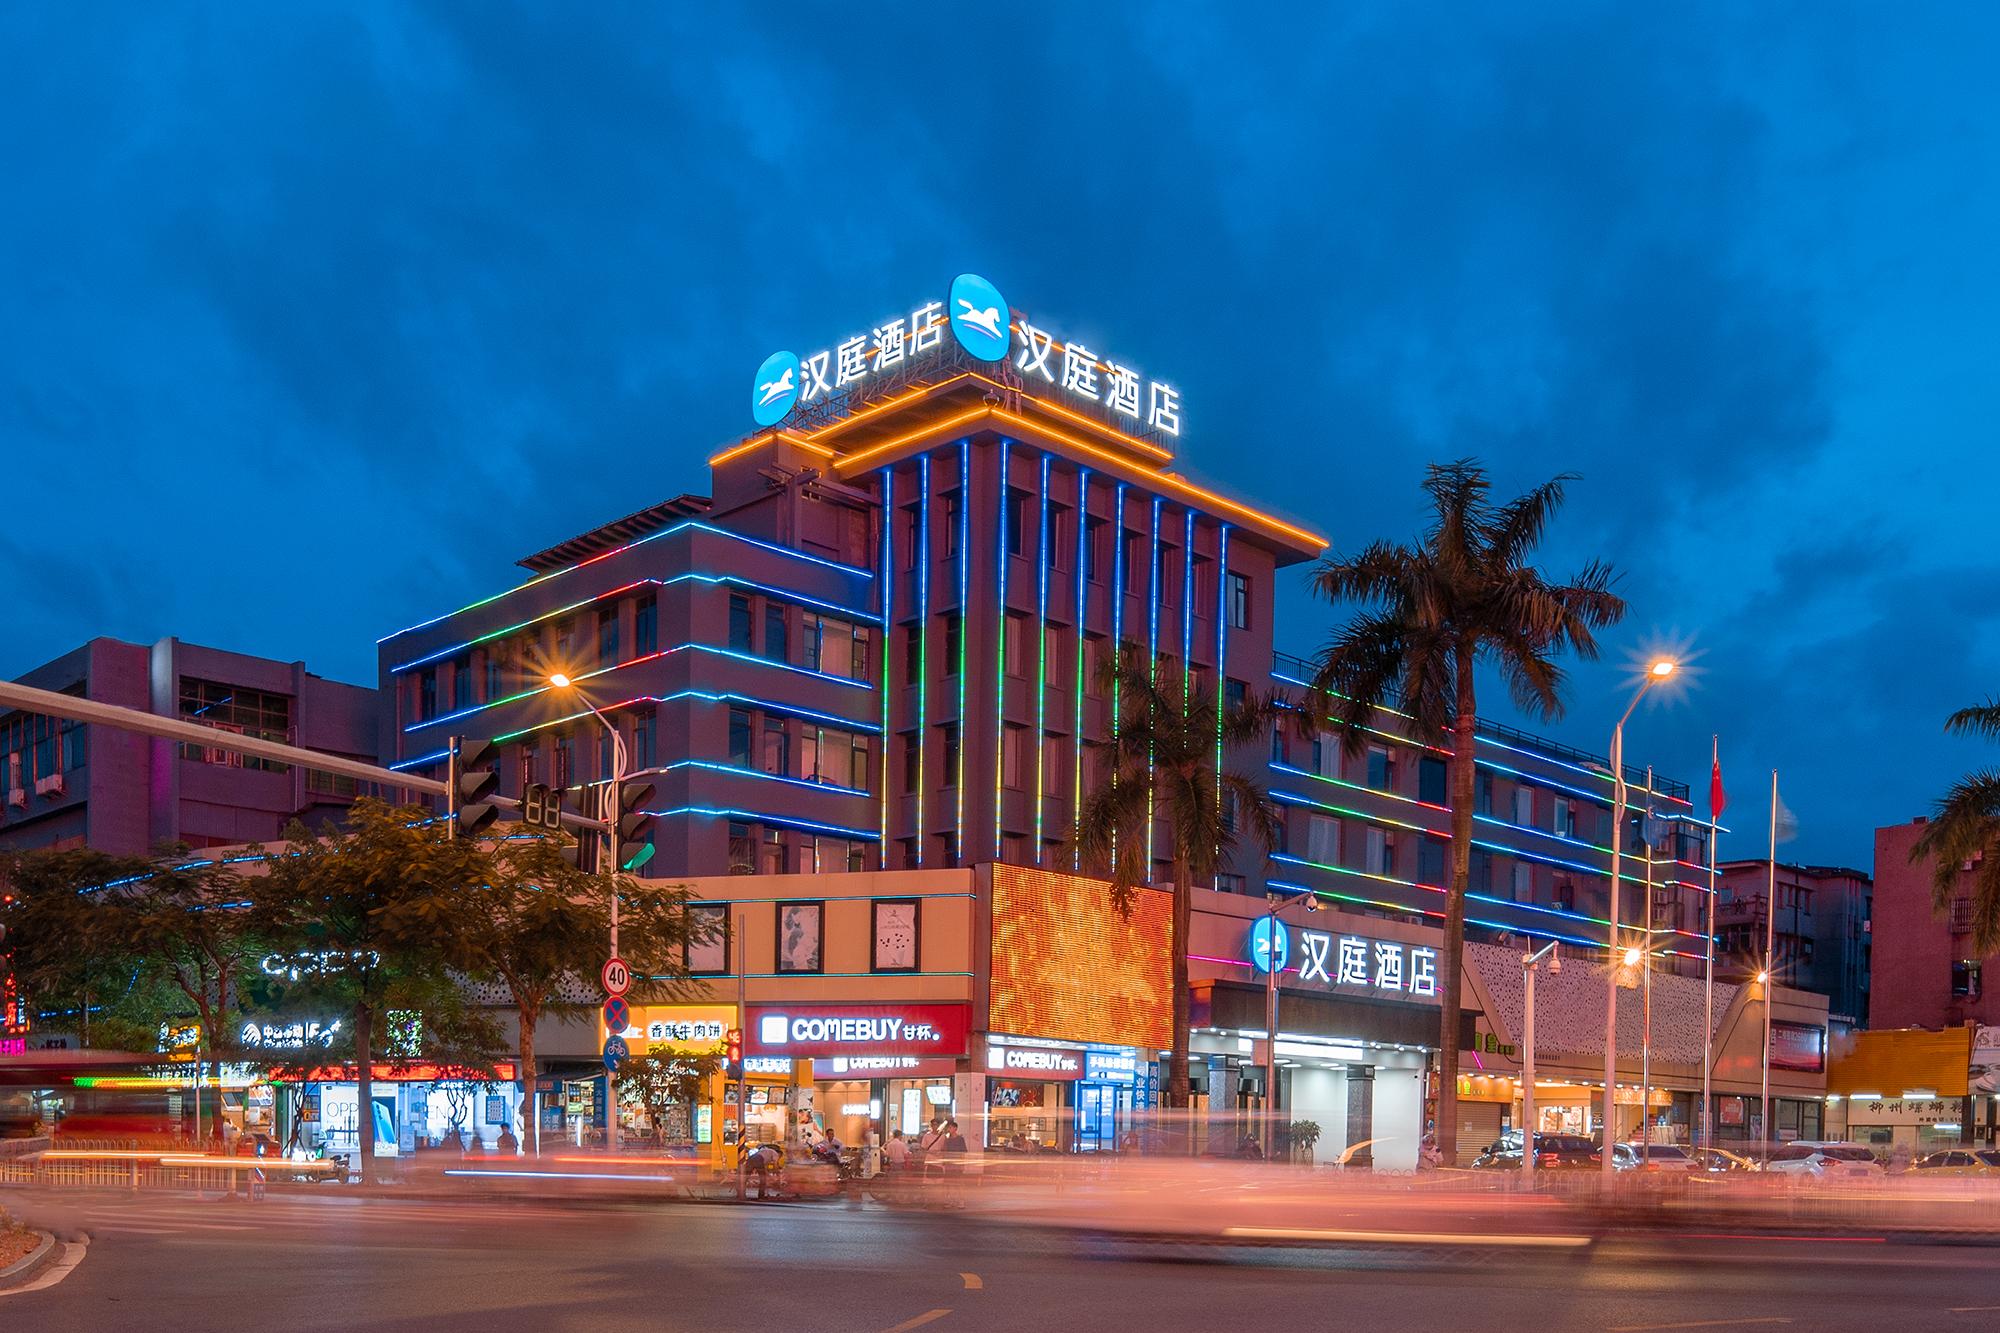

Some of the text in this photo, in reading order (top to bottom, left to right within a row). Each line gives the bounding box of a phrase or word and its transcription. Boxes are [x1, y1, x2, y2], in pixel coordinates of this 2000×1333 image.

[801, 303, 942, 401] 汉庭酒店
[1017, 320, 1180, 436] 汉庭酒店
[608, 966, 625, 985] 40
[1299, 932, 1436, 997] 汉庭酒店
[792, 1018, 902, 1041] COMEBUY
[1006, 1051, 1062, 1070] COMEBUY
[326, 1101, 359, 1119] OPP
